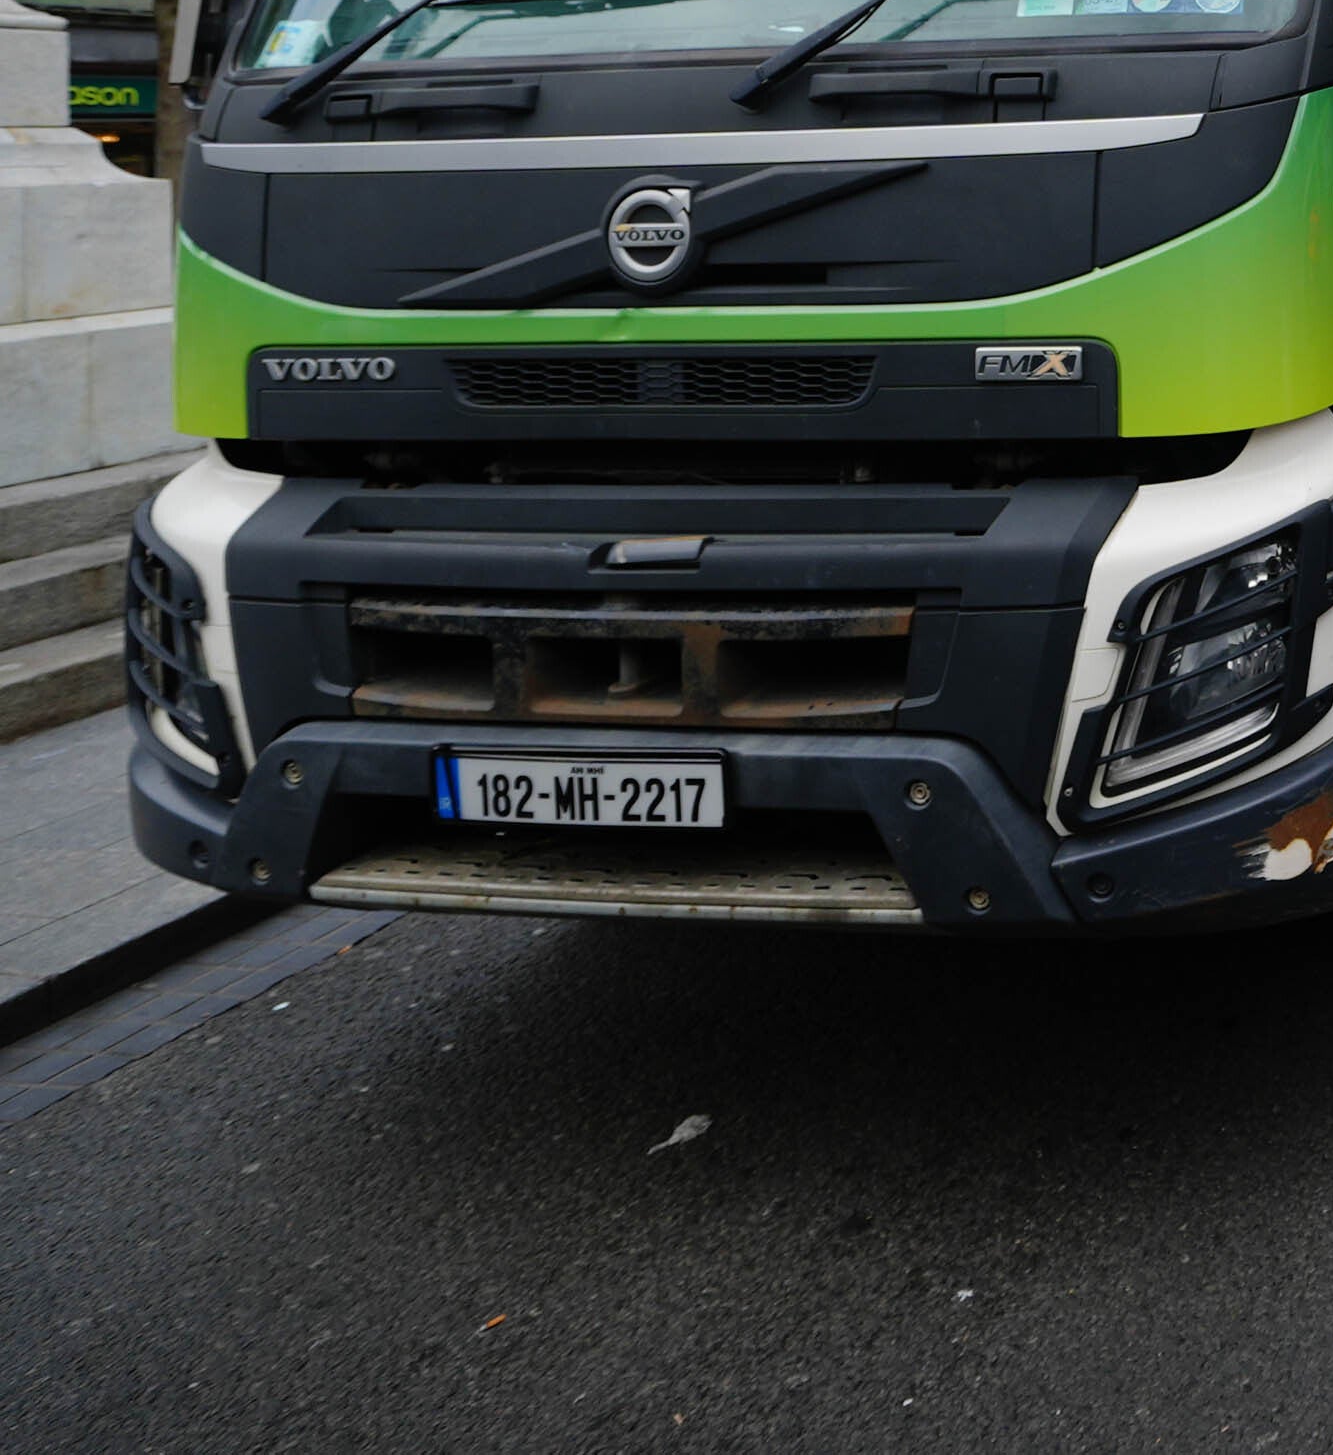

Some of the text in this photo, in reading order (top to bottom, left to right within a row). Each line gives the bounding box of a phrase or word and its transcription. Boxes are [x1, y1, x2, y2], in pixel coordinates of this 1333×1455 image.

[613, 229, 685, 242] VOLVO
[261, 357, 396, 381] VOLVO
[978, 350, 1077, 378] FMX
[477, 772, 706, 823] 182-MH-2217
